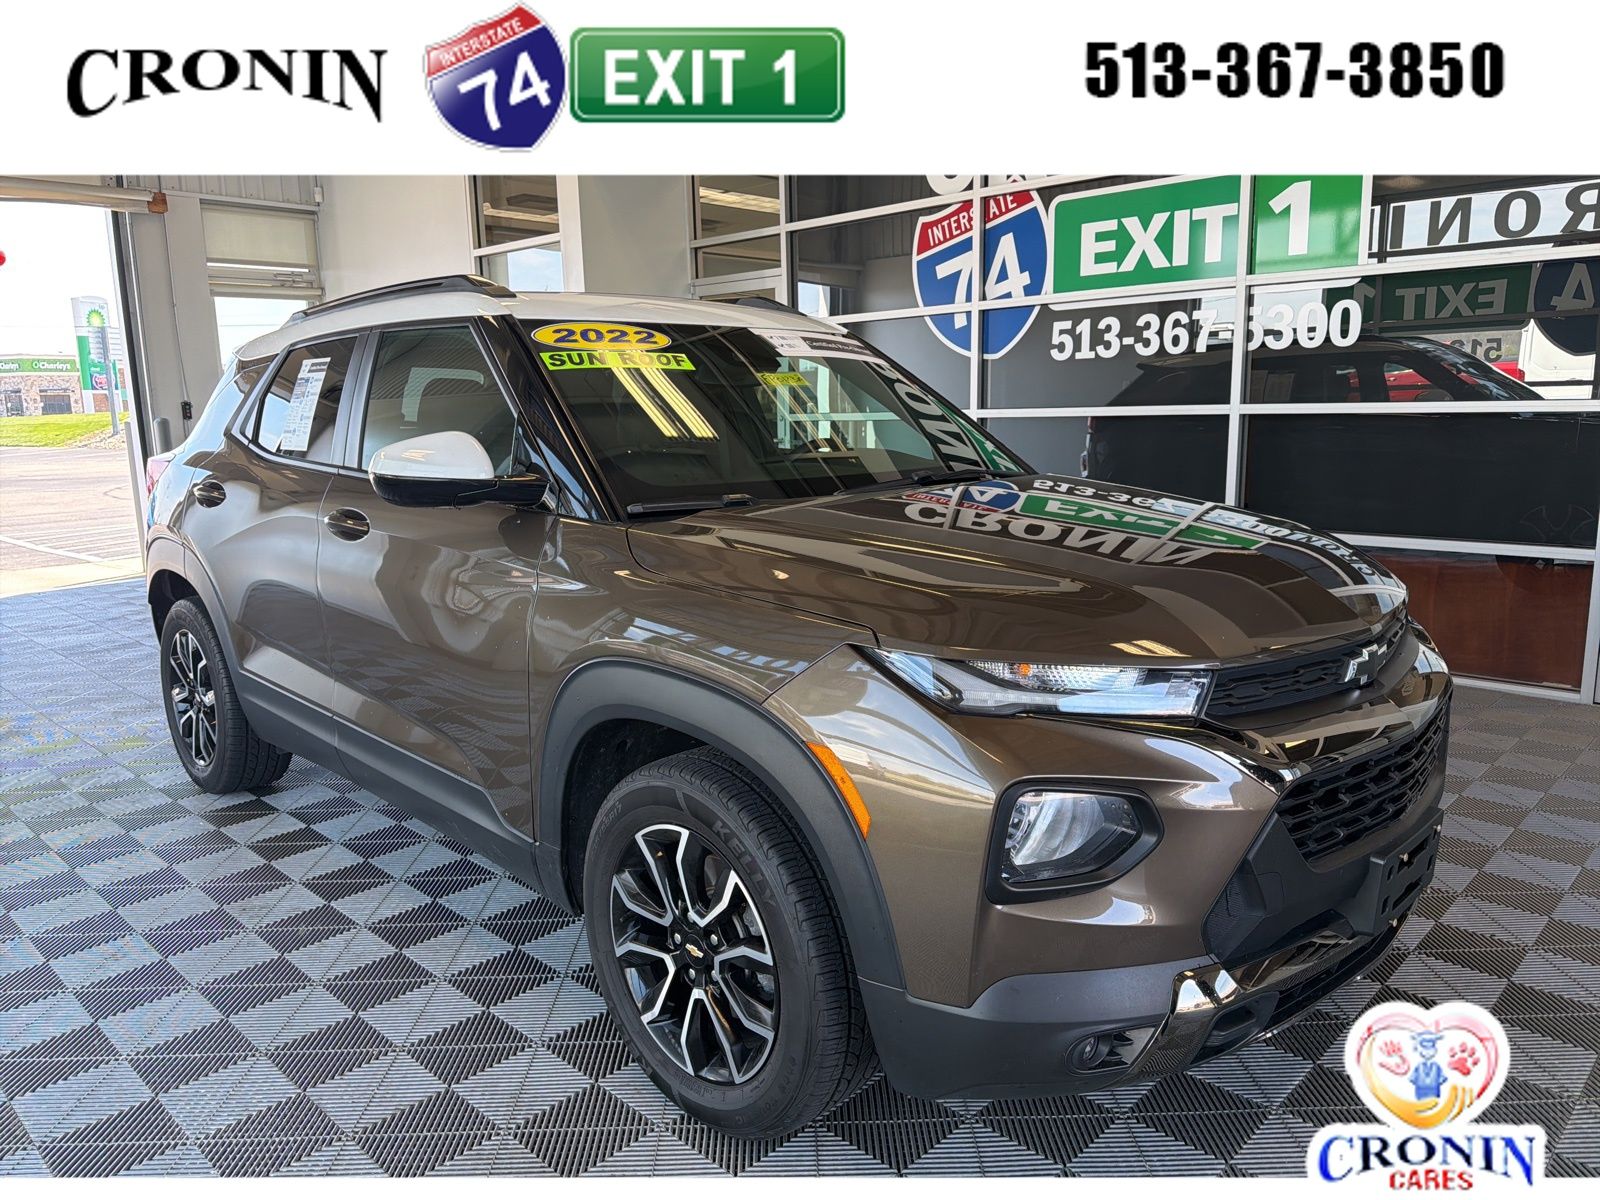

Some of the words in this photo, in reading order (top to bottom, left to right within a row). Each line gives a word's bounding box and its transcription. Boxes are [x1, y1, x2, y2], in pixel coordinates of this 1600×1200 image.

[1080, 202, 1239, 278] EXIT
[1267, 180, 1312, 257] 1
[935, 231, 1032, 330] 74
[548, 351, 608, 367] SUN
[617, 351, 687, 368] ROOF
[551, 328, 658, 345] 2022
[711, 820, 778, 908] KELLY
